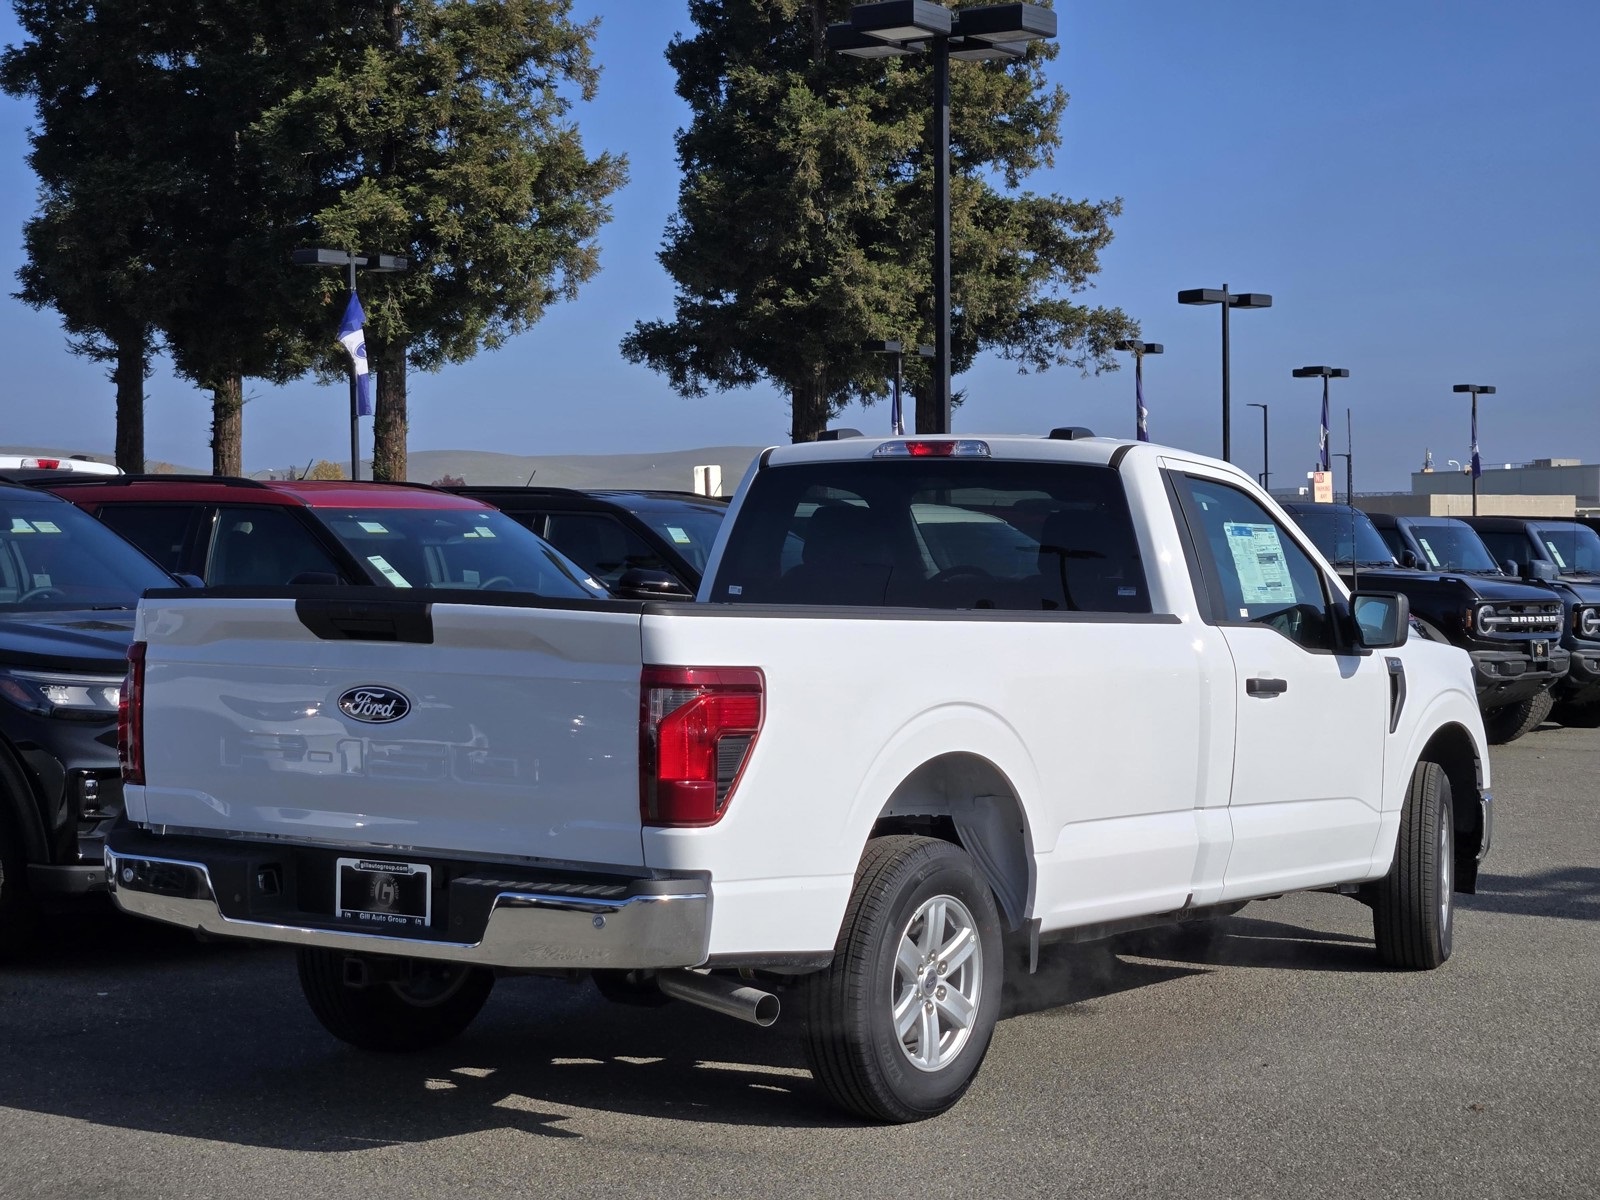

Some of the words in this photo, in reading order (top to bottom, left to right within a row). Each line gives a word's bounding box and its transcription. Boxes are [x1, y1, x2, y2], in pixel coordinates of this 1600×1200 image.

[1315, 473, 1324, 483] NO
[1510, 615, 1556, 623] BRONCO
[349, 691, 397, 717] Ford
[360, 863, 408, 871] gillautogroup.com
[359, 912, 370, 920] Gill
[371, 914, 387, 922] Auto
[387, 915, 407, 924] Group
